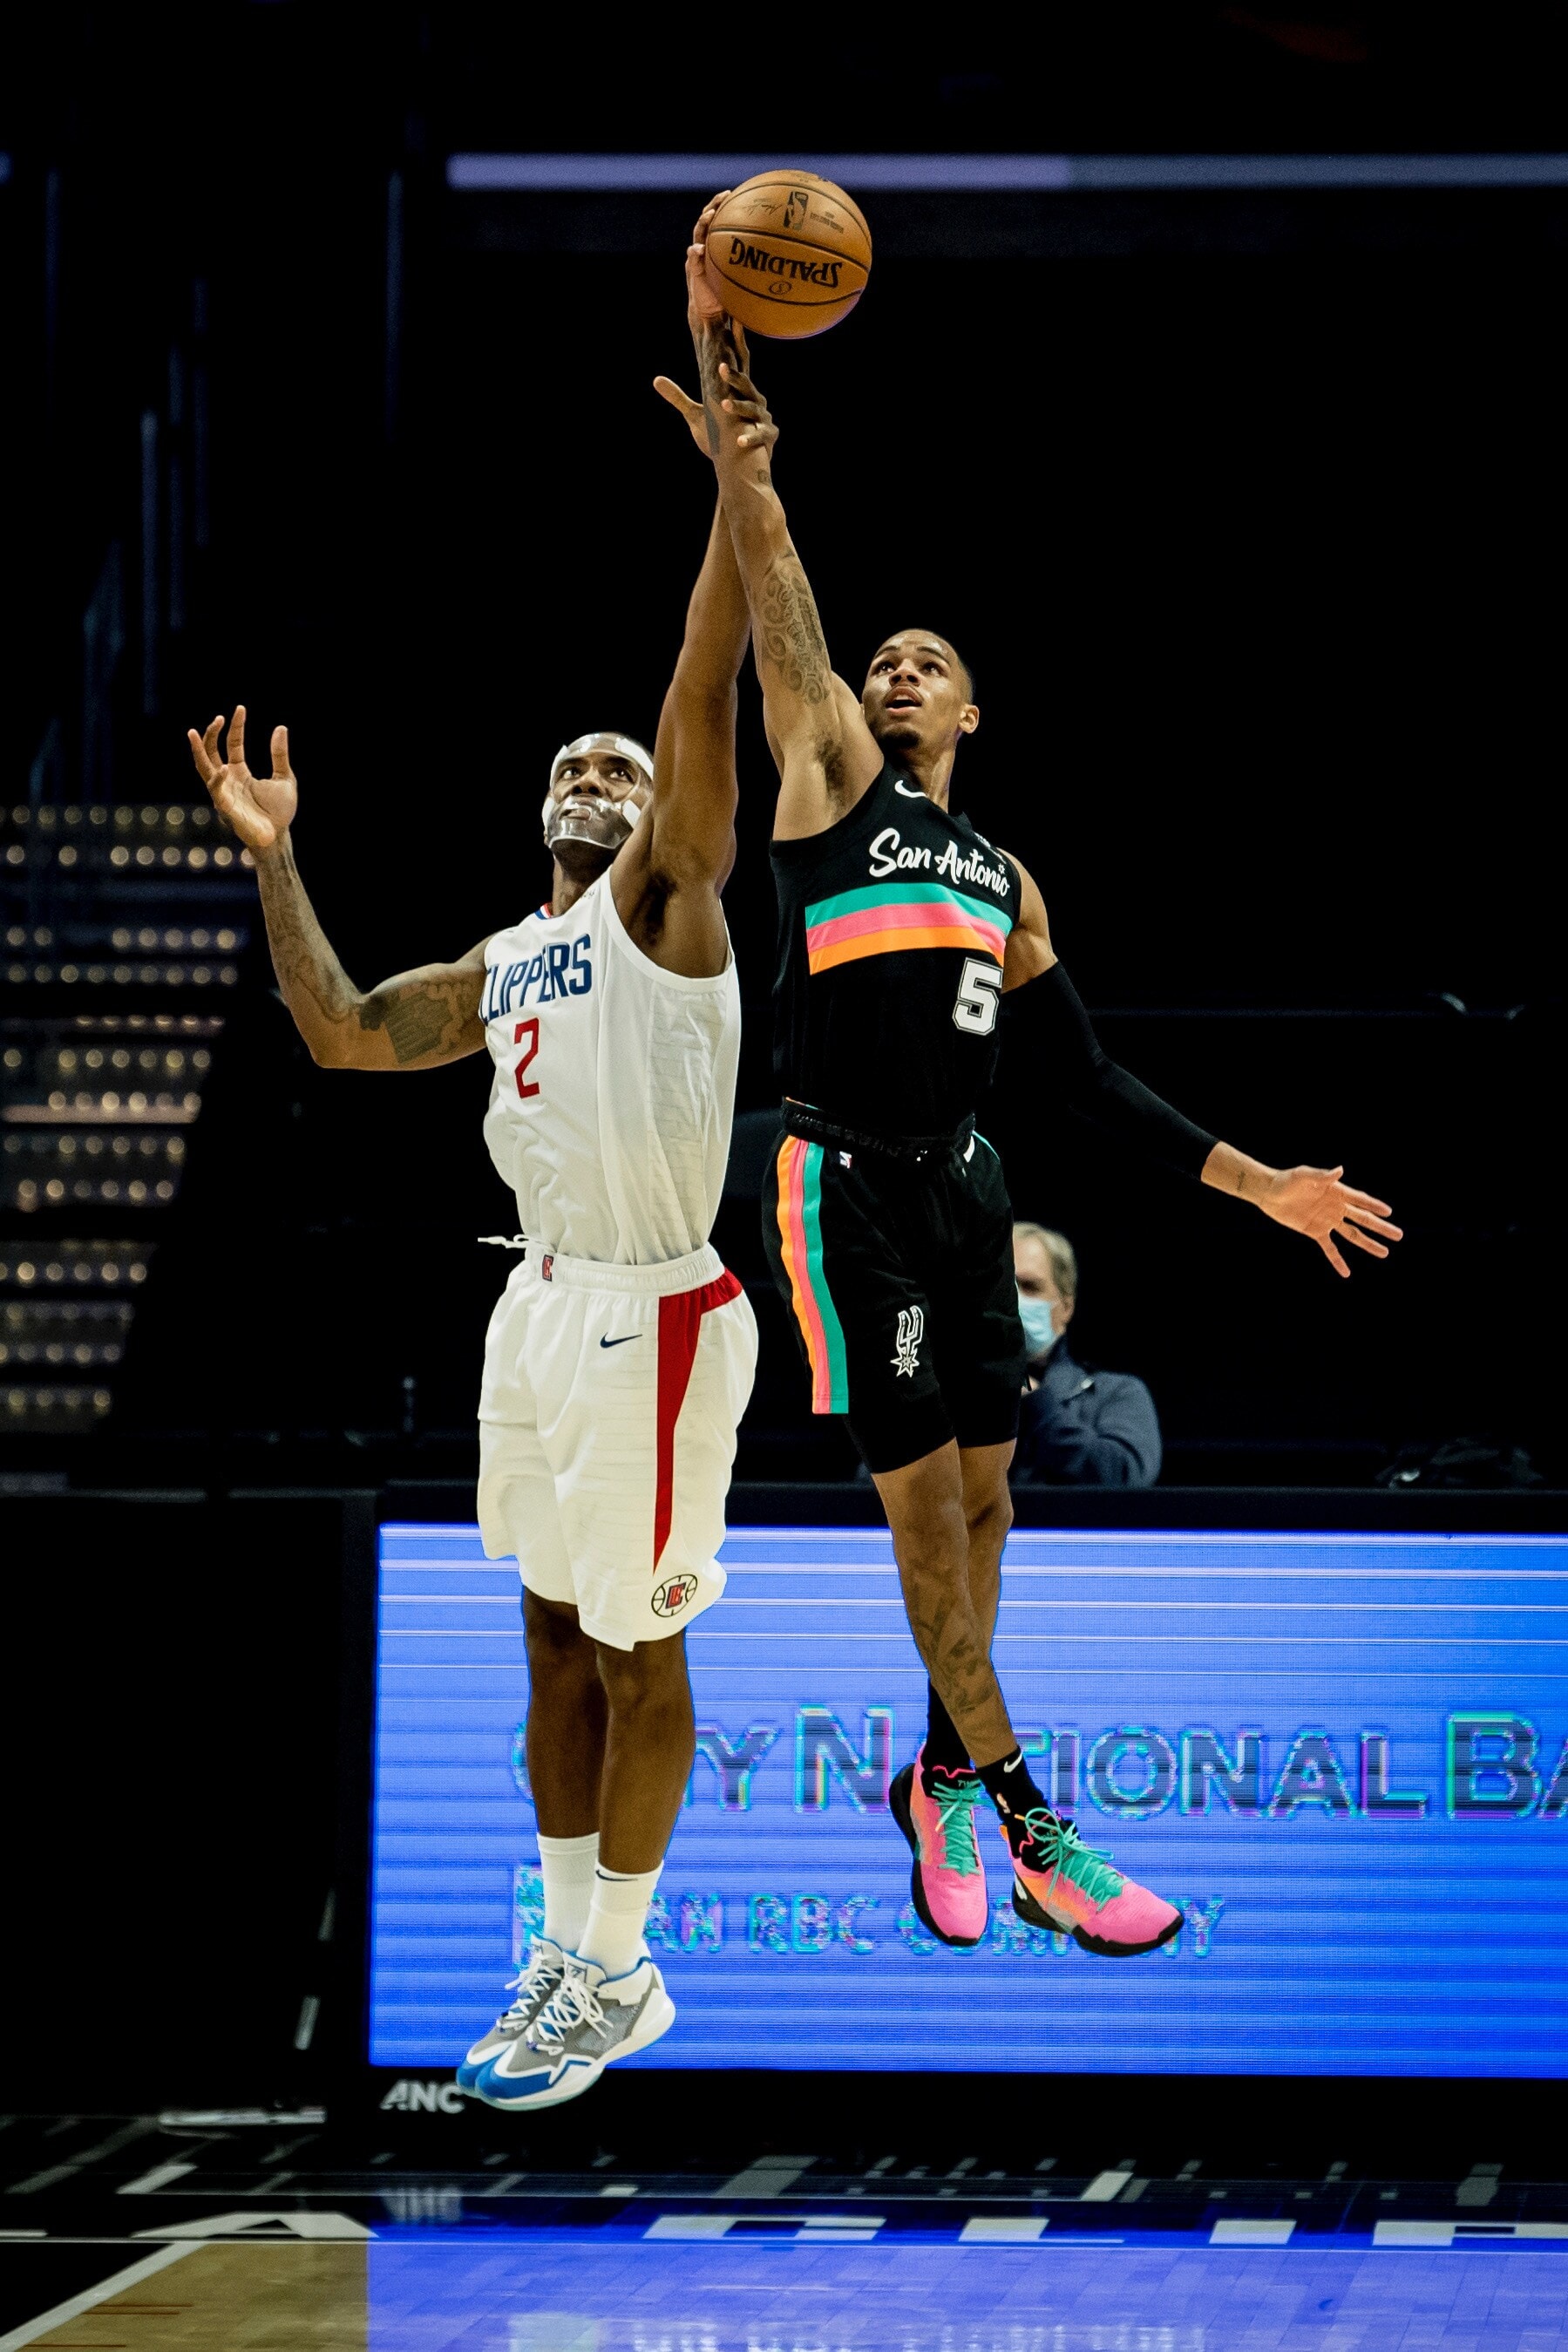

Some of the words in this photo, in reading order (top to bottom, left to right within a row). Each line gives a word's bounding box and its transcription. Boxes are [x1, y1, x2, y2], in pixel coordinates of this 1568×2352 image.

[729, 236, 843, 289] SPALDING
[869, 827, 931, 878] San
[934, 840, 1010, 897] Antonio
[952, 956, 1003, 1036] 5
[514, 1017, 540, 1098] 2
[750, 1892, 878, 1955] RBC
[379, 2079, 465, 2114] ANC
